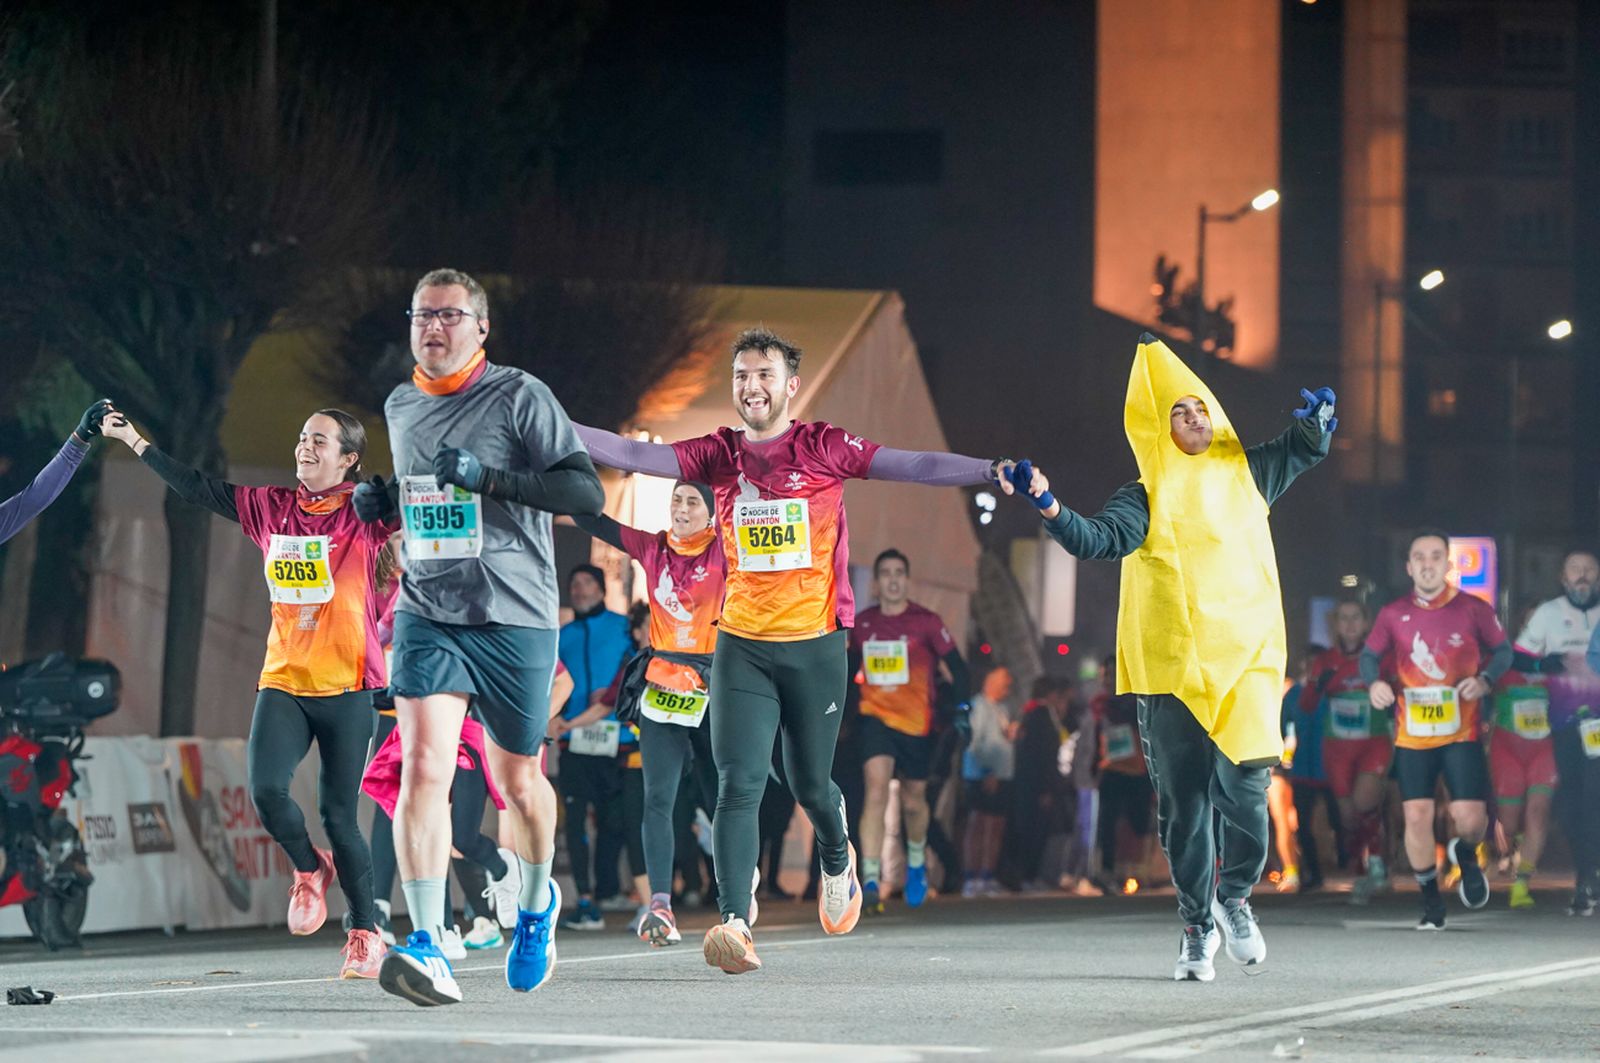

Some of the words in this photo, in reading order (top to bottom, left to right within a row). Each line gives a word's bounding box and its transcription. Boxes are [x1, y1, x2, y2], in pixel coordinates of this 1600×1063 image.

[412, 505, 465, 531] 9595
[769, 507, 779, 515] DE
[748, 524, 796, 548] 5264
[274, 560, 318, 581] 5263
[664, 597, 679, 612] 43
[656, 691, 696, 711] 5612
[1422, 705, 1444, 719] 728
